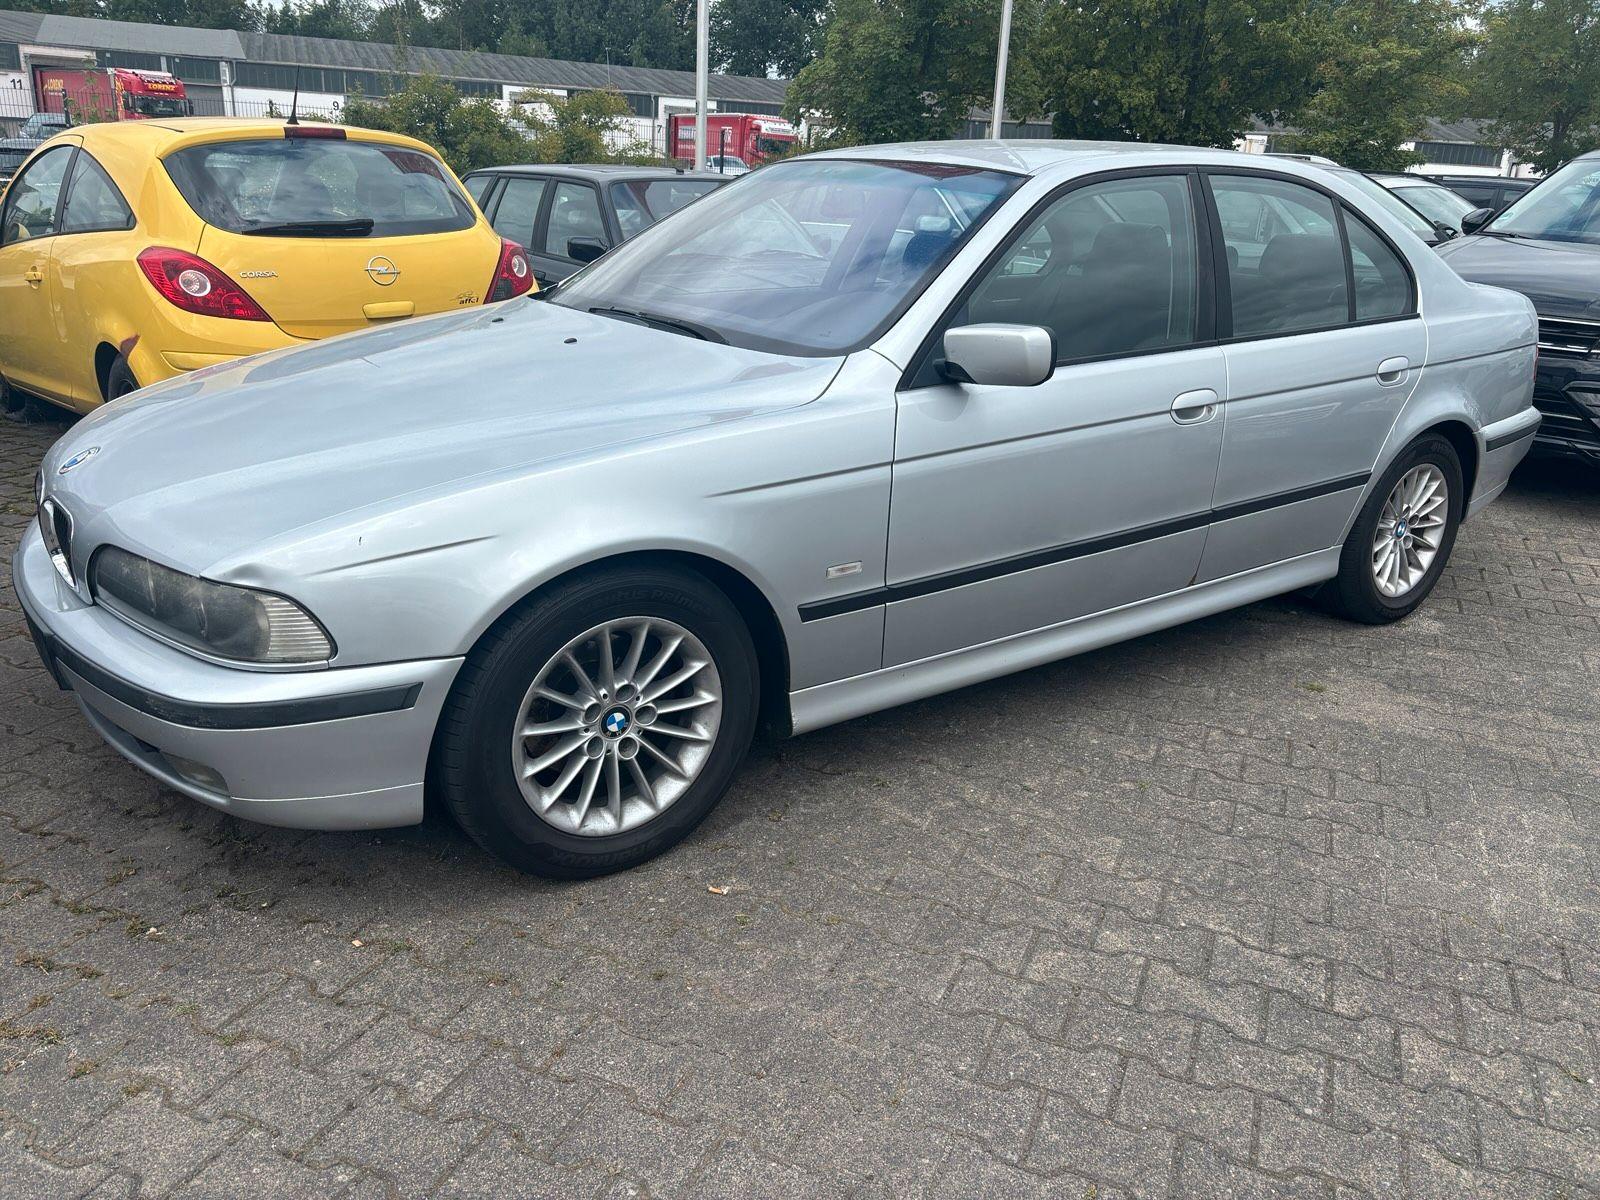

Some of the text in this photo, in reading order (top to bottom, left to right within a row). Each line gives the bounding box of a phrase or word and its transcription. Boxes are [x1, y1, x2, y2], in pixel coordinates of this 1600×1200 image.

[10, 78, 22, 90] 11
[148, 83, 175, 92] LORENZ
[332, 101, 340, 111] 9
[656, 124, 663, 134] 7
[239, 270, 278, 279] CORSA
